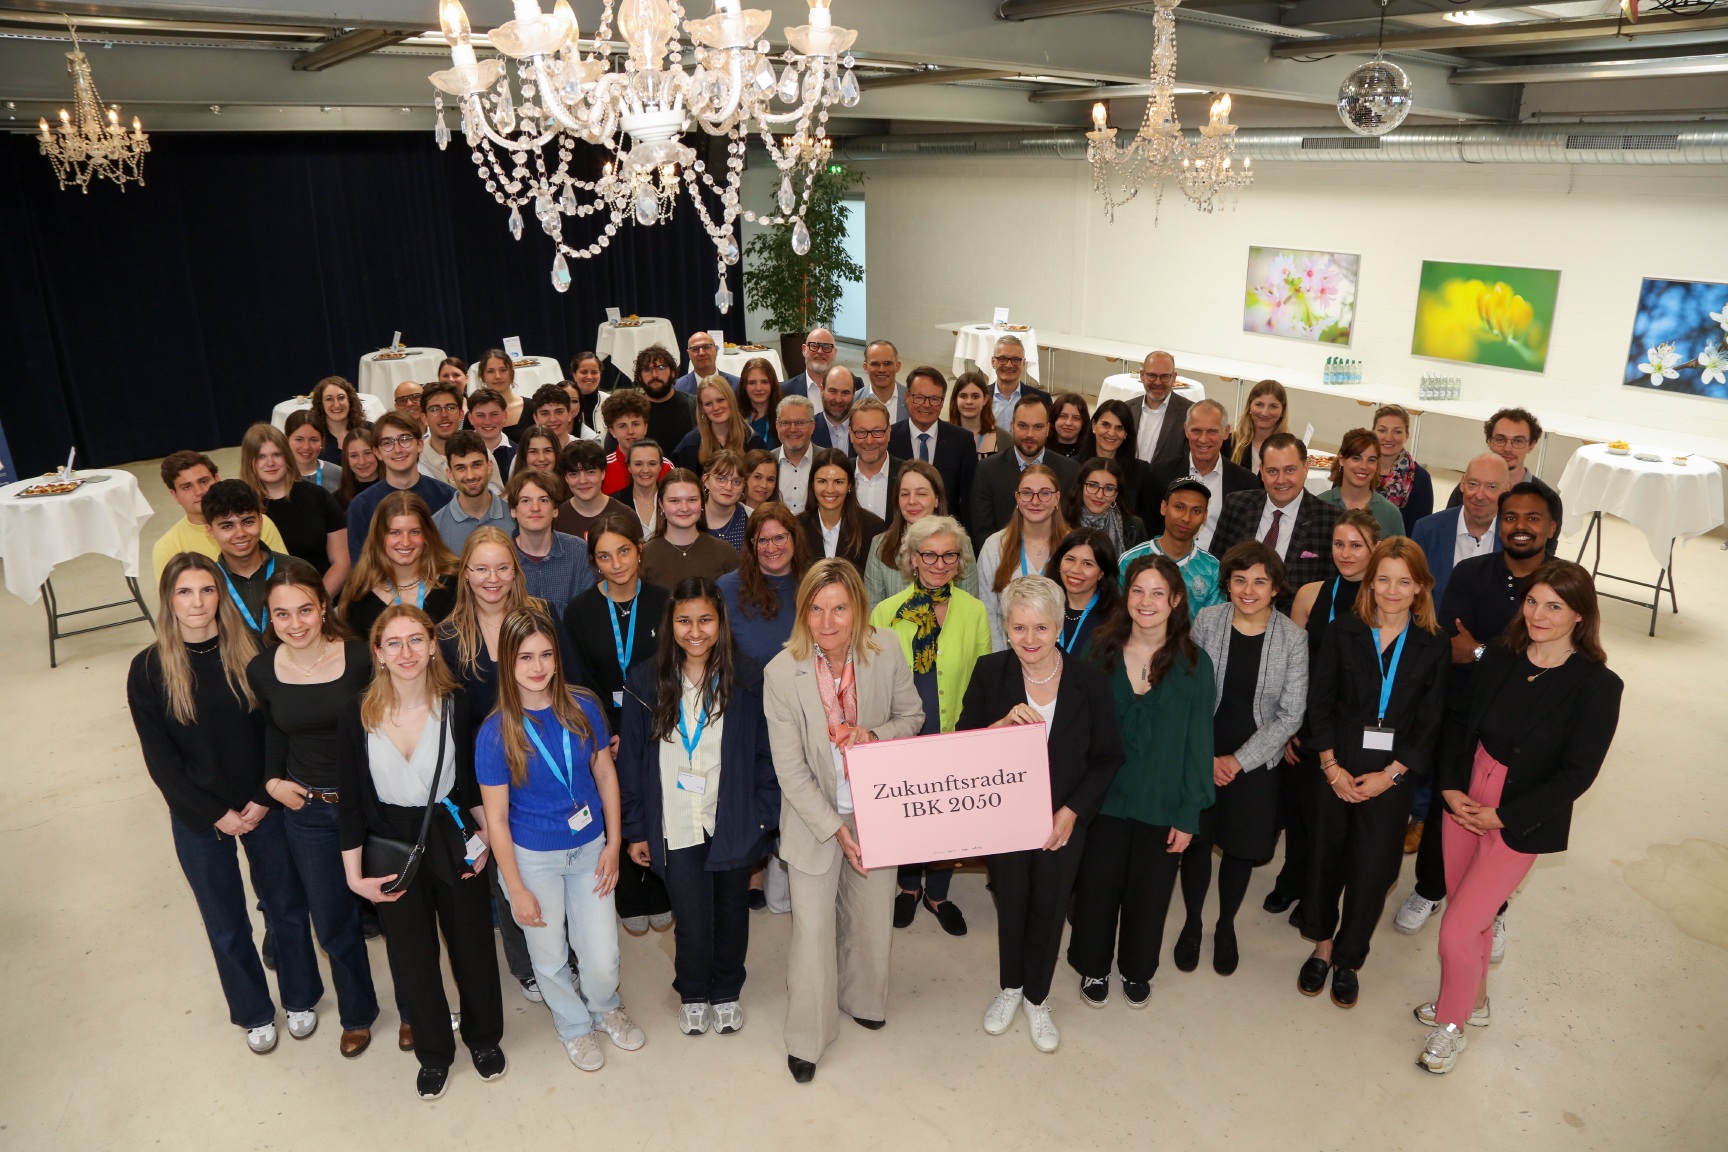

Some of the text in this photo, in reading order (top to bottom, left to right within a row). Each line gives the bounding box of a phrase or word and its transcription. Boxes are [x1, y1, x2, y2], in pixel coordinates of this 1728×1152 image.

[874, 769, 1028, 799] Zukunftsradar
[903, 793, 1002, 818] IBK 2050
